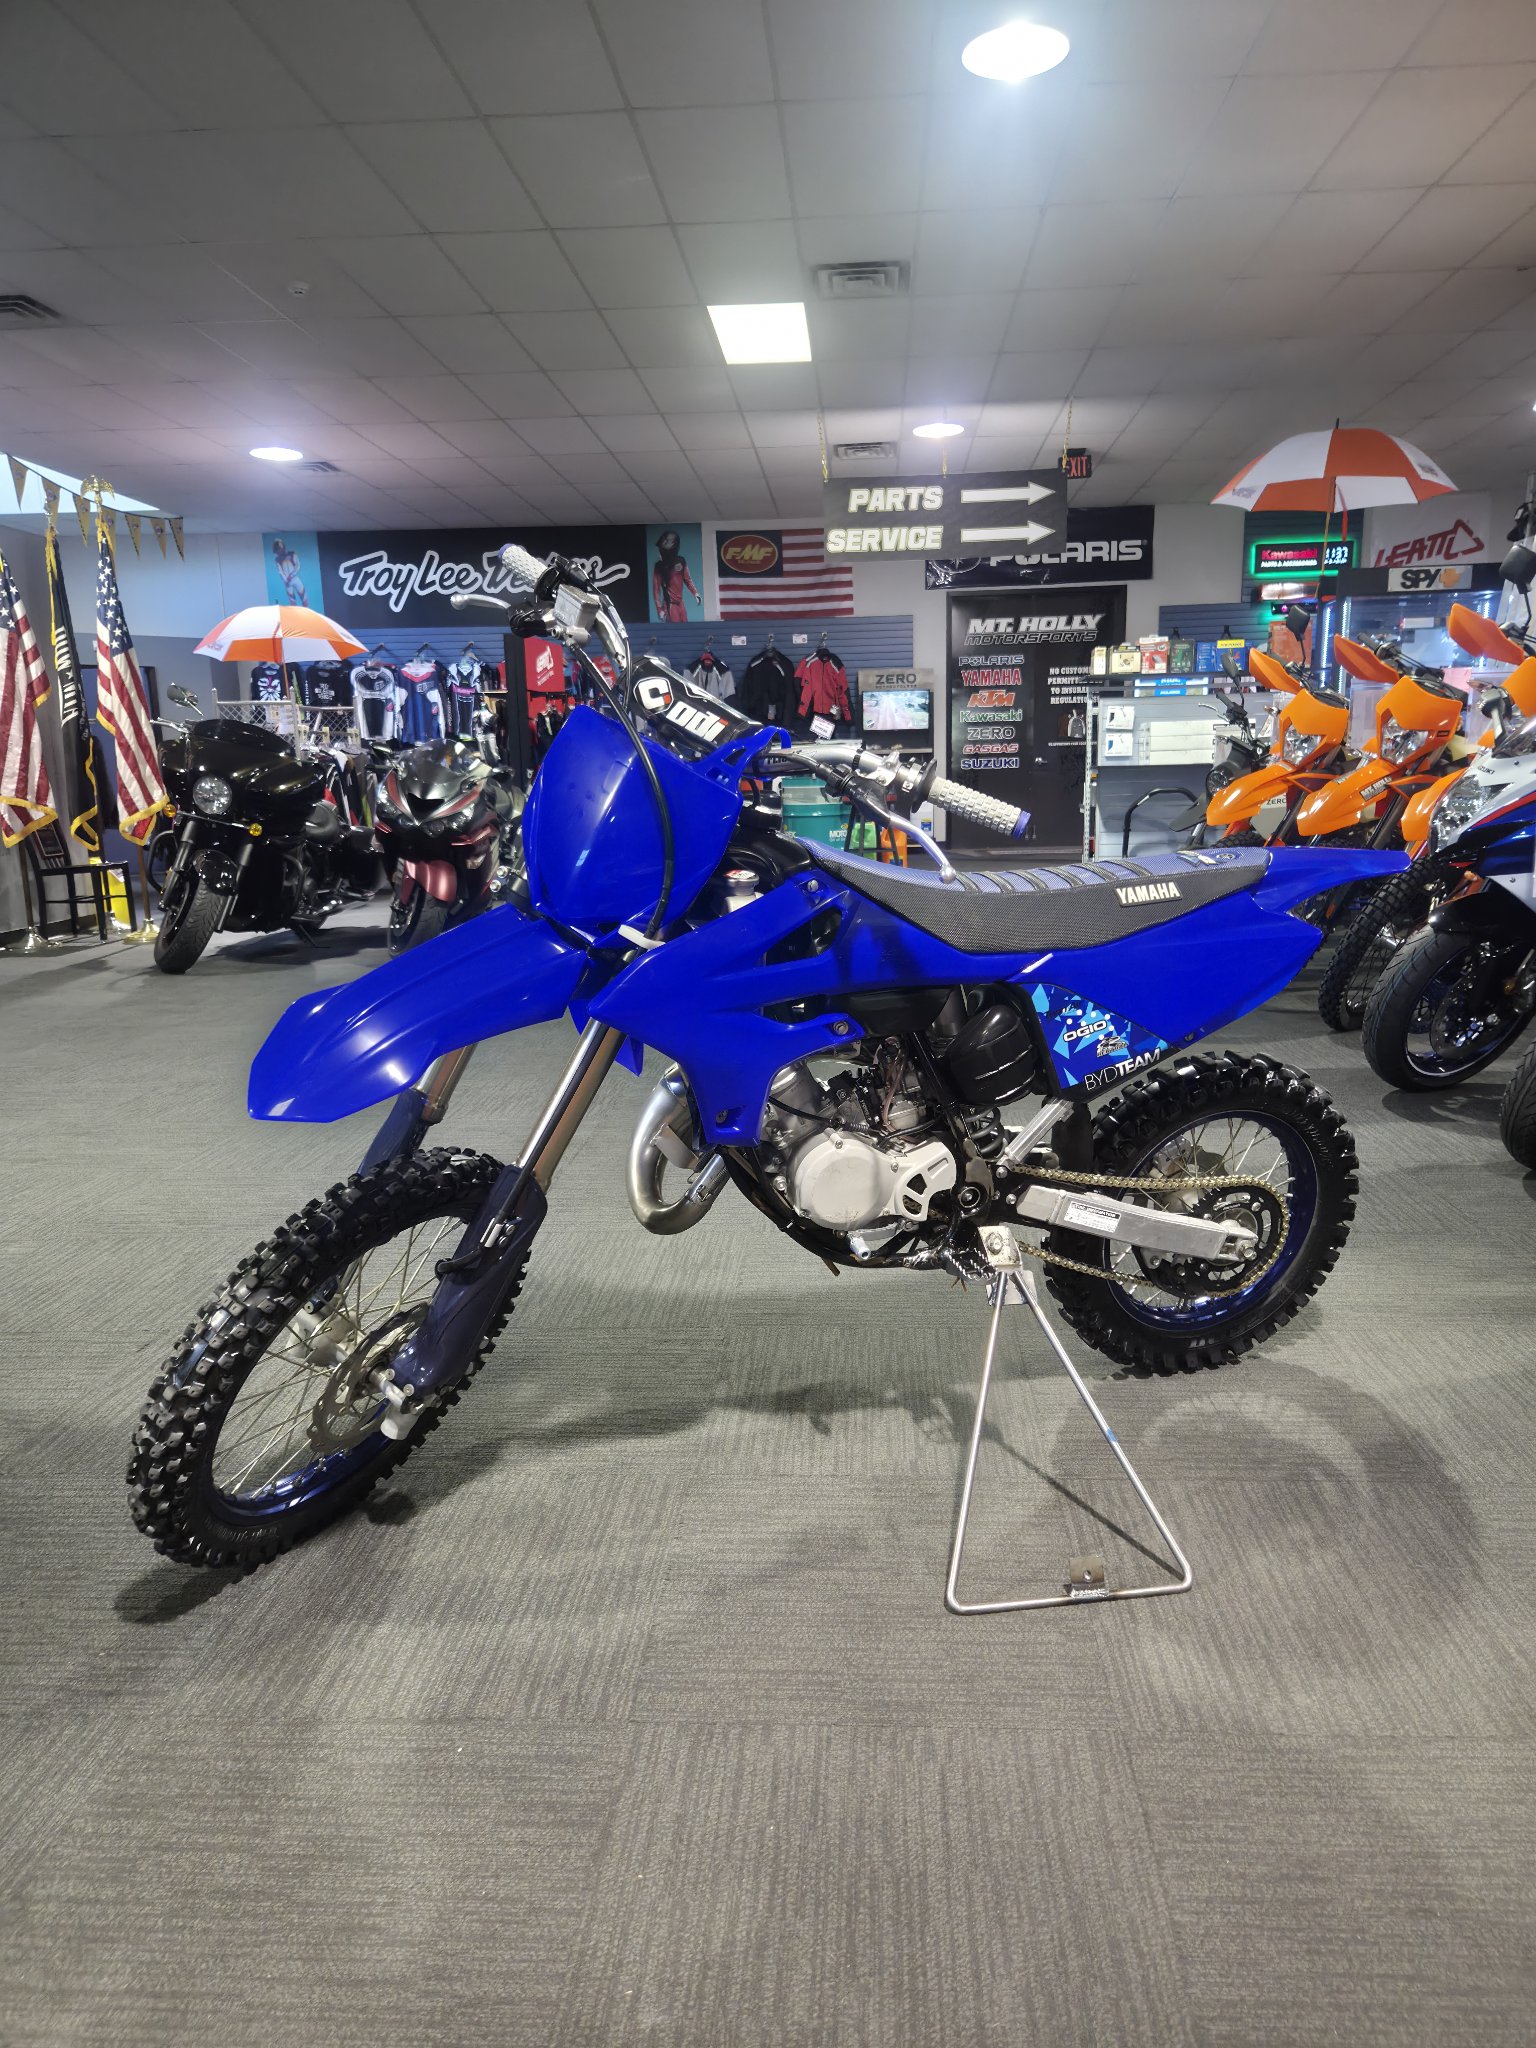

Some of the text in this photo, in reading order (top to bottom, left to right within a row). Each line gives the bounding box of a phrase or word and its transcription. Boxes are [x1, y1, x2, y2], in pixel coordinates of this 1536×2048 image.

[848, 485, 944, 513] PARTS
[827, 525, 944, 554] SERVICE
[725, 544, 774, 560] FMF
[1261, 549, 1318, 560] Kawasaki
[339, 551, 417, 612] Troy
[413, 551, 483, 596] Lee
[1400, 568, 1442, 589] SPY
[968, 614, 1105, 634] MT. HOLLY
[964, 631, 1098, 645] MOTORSPORTS
[959, 655, 1025, 666] POLARIS
[875, 674, 917, 685] ZERO
[961, 668, 1022, 686] YAMAHA
[967, 690, 1016, 707] KTM
[1051, 687, 1061, 695] TO
[960, 709, 1023, 723] Kawasaki
[968, 727, 1016, 740] ZERO
[963, 744, 1019, 754] GASGAS
[961, 757, 1020, 769] SUZUKI
[1116, 881, 1180, 904] YAMAHA
[1063, 1020, 1107, 1042] OGIO
